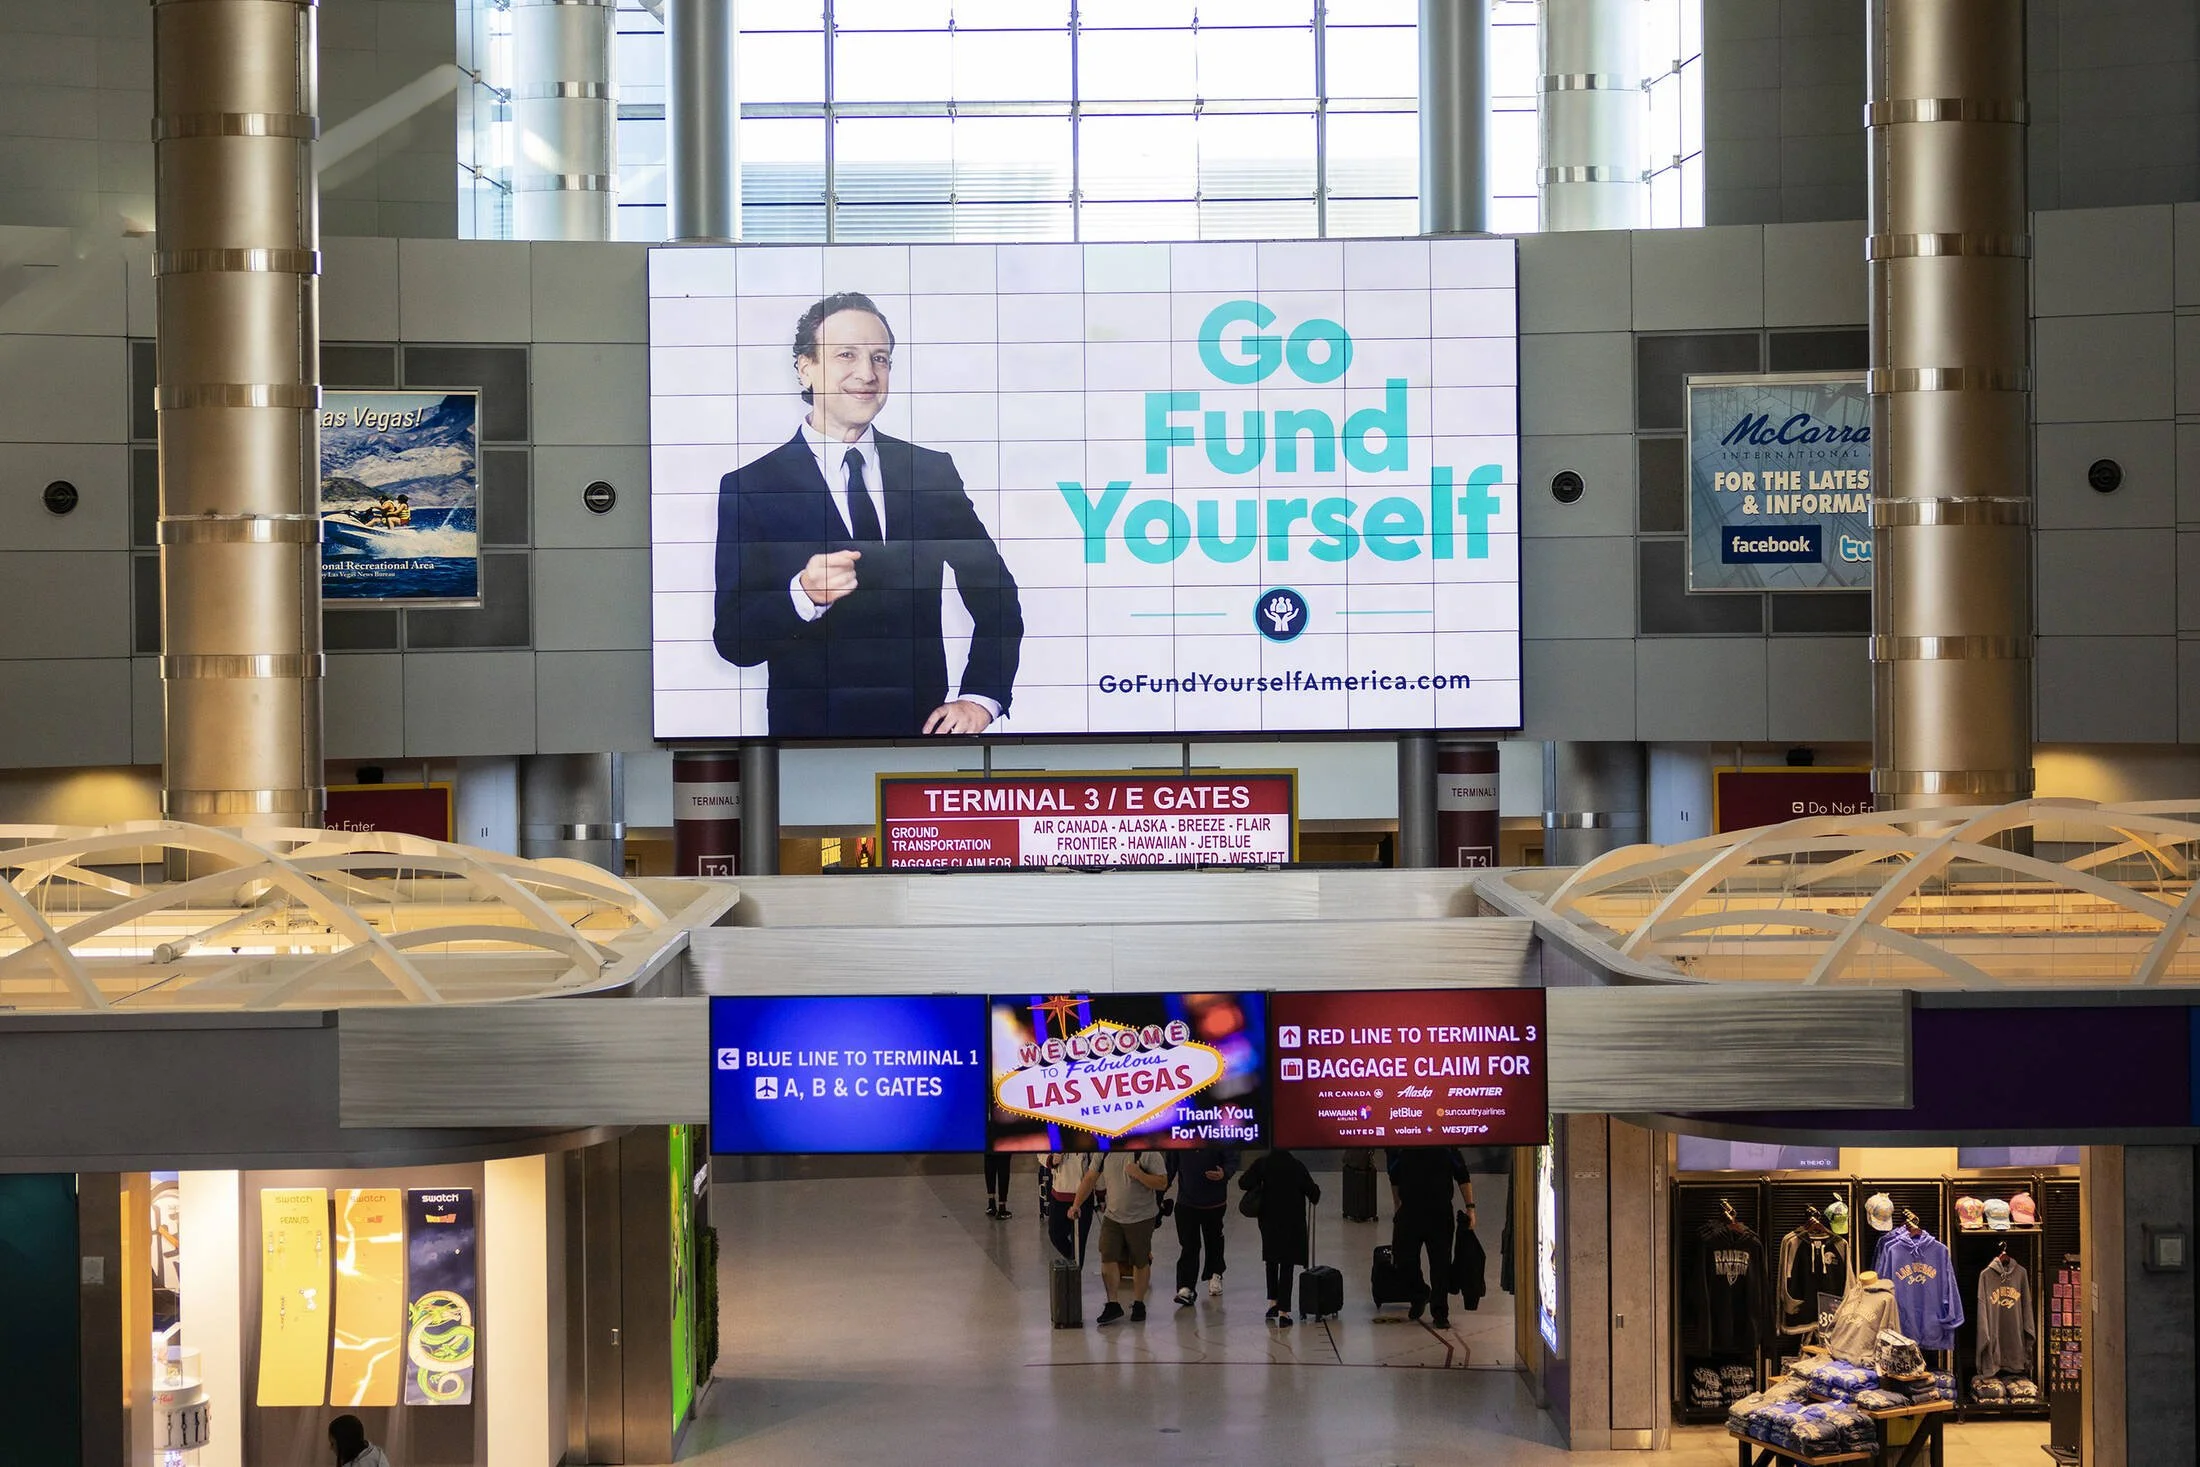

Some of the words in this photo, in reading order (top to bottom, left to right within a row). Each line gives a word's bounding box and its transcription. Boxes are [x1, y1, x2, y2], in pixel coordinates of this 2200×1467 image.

[1198, 300, 1353, 385] Go
[320, 411, 347, 427] as
[353, 407, 423, 431] Vegas!
[1145, 378, 1408, 474] Fund
[1721, 413, 1871, 446] McCarra
[1723, 449, 1860, 460] INTERNATIONAL
[1714, 472, 1756, 492] FOR
[1762, 471, 1801, 491] THE
[1809, 470, 1871, 490] LATES
[1743, 495, 1760, 515] &
[1056, 464, 1503, 564] Yourself
[1732, 536, 1810, 552] facebook
[346, 561, 409, 570] Recreational
[411, 560, 435, 570] Area
[340, 571, 356, 579] Vegas
[1099, 670, 1471, 694] GoFundYourselfAmerica.com
[924, 788, 1075, 812] TERMINAL
[1084, 788, 1100, 810] 3
[1107, 787, 1117, 810] /
[1126, 787, 1144, 810] E
[1153, 786, 1250, 809] GATES
[1452, 788, 1492, 797] TERMINAL
[692, 796, 734, 806] TERMINAL
[1809, 802, 1828, 814] Do
[1832, 802, 1855, 814] Not
[324, 822, 339, 831] ot
[344, 820, 375, 831] Enter
[892, 827, 939, 838] GROUND
[1034, 820, 1054, 834] AIR
[1057, 819, 1108, 833] CANADA
[1118, 819, 1168, 833] ALASKA
[1178, 818, 1225, 831] BREEZE
[1236, 818, 1271, 831] FLAIR
[892, 839, 991, 851] TRANSPORTATION
[1057, 836, 1117, 850] FRONTIER
[1128, 836, 1187, 849] HAWAIIAN
[1197, 835, 1251, 849] JETBLUE
[892, 858, 948, 867] BAGGAGE
[950, 857, 985, 867] CLAIM
[989, 857, 1012, 867] FOR
[1023, 854, 1048, 866] SUN
[1051, 854, 1109, 866] COUNTRY
[1120, 853, 1164, 864] SWOOP
[1175, 853, 1218, 864] UNITED
[1230, 852, 1285, 863] WESTJET
[1466, 856, 1487, 867] T3
[706, 865, 728, 876] T3
[1308, 1029, 1345, 1045] RED
[1351, 1028, 1392, 1044] LINE
[1398, 1027, 1421, 1043] TO
[1427, 1026, 1520, 1043] TERMINAL
[1526, 1025, 1536, 1041] 3
[1020, 1024, 1186, 1063] WELCOME
[746, 1051, 792, 1067] BLUE
[799, 1051, 838, 1066] LINE
[843, 1051, 867, 1066] TO
[868, 1050, 963, 1066] TERMINAL
[969, 1050, 978, 1065] 1
[1041, 1068, 1059, 1079] TO
[1066, 1054, 1168, 1079] Fabulous
[1307, 1057, 1408, 1079] BAGGAGE
[1414, 1056, 1480, 1077] CLAIM
[1488, 1055, 1530, 1075] FOR
[784, 1078, 804, 1100] A,
[812, 1078, 826, 1097] B
[834, 1077, 848, 1097] &
[855, 1077, 869, 1096] C
[875, 1077, 943, 1097] GATES
[1026, 1079, 1082, 1109] LAS
[1091, 1065, 1193, 1100] VEGAS
[1397, 1085, 1434, 1098] Alaska
[1448, 1087, 1503, 1097] FRONTIER
[1081, 1100, 1144, 1116] NEVADA
[1176, 1107, 1222, 1121] Thank
[1224, 1106, 1254, 1120] You
[1318, 1109, 1358, 1117] HAWAIIAN
[1390, 1107, 1423, 1119] jetBlue
[1171, 1126, 1196, 1140] For
[1199, 1124, 1259, 1141] Visiting!
[1442, 1126, 1479, 1135] WESTJET
[275, 1195, 313, 1204] swatch
[421, 1194, 459, 1203] swatch
